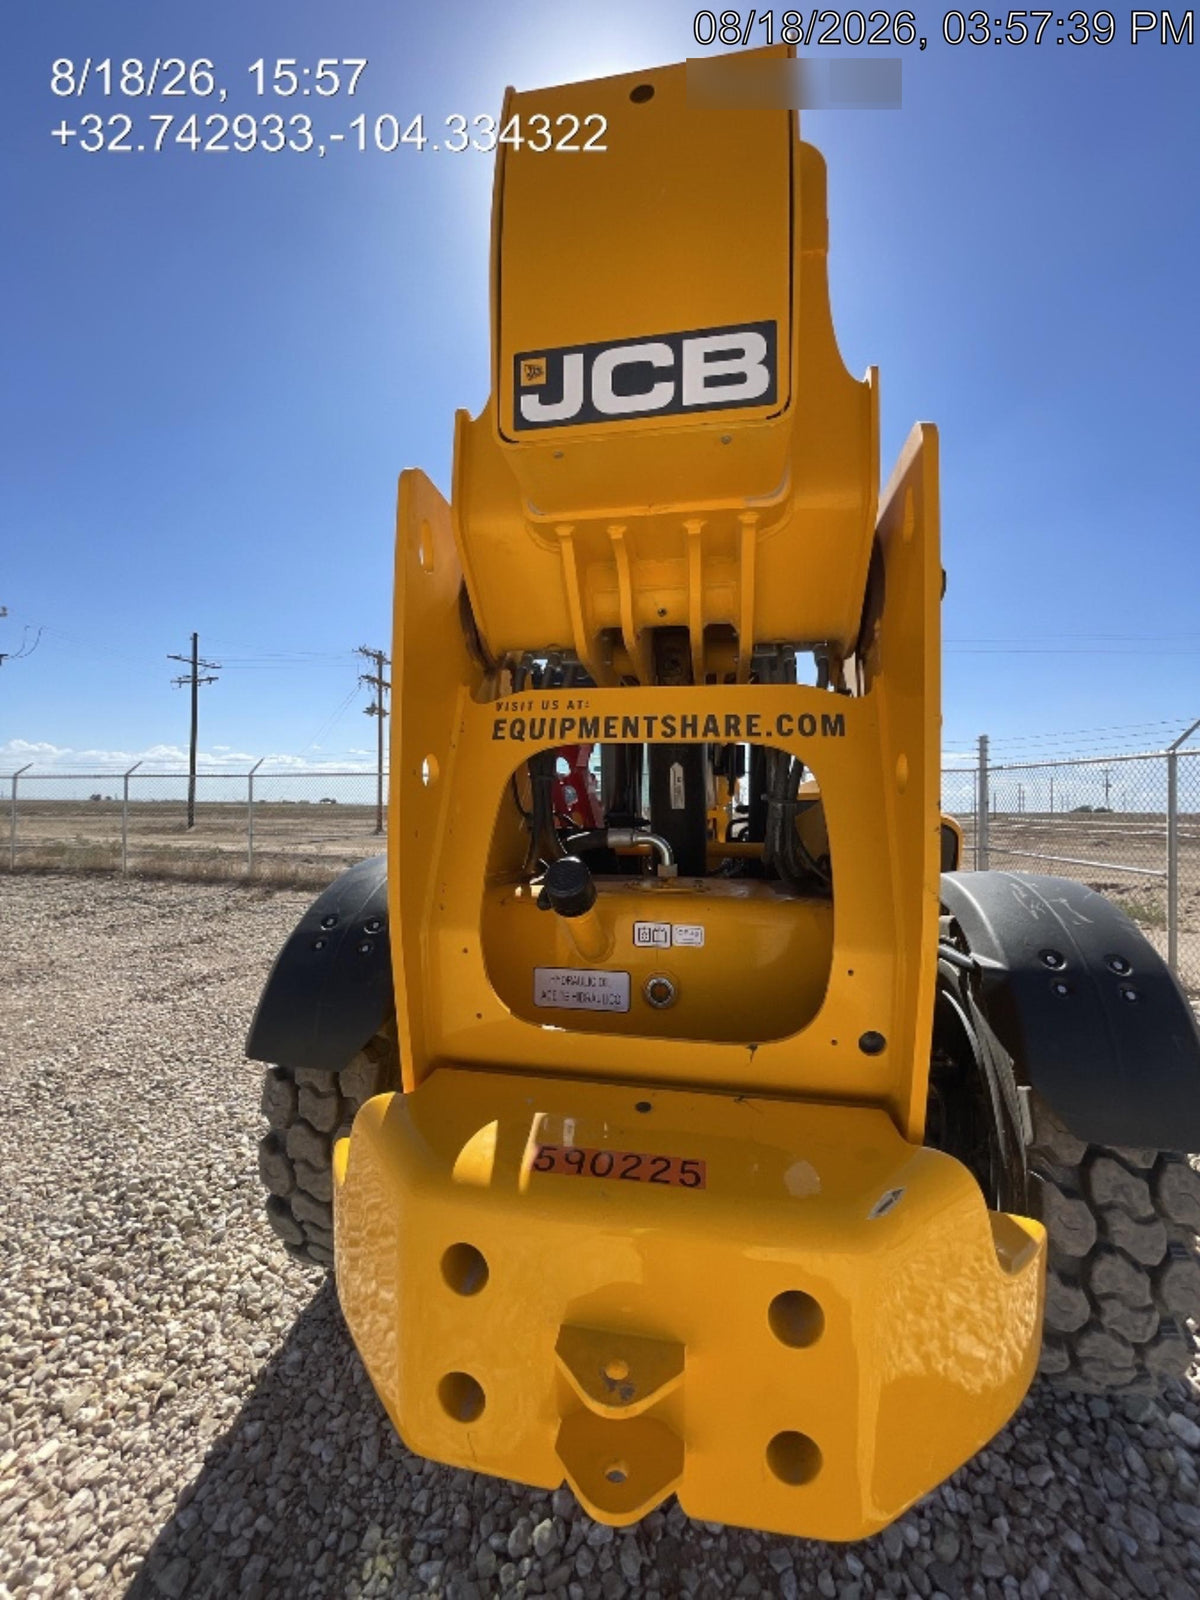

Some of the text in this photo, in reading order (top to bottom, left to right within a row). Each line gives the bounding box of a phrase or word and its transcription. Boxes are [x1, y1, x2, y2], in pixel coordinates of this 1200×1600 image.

[520, 332, 770, 422] JCB
[496, 701, 533, 712] VISIT
[541, 700, 559, 711] US
[492, 713, 846, 742] EQUIPMENTSHARE.COM
[533, 1146, 702, 1188] 590225
